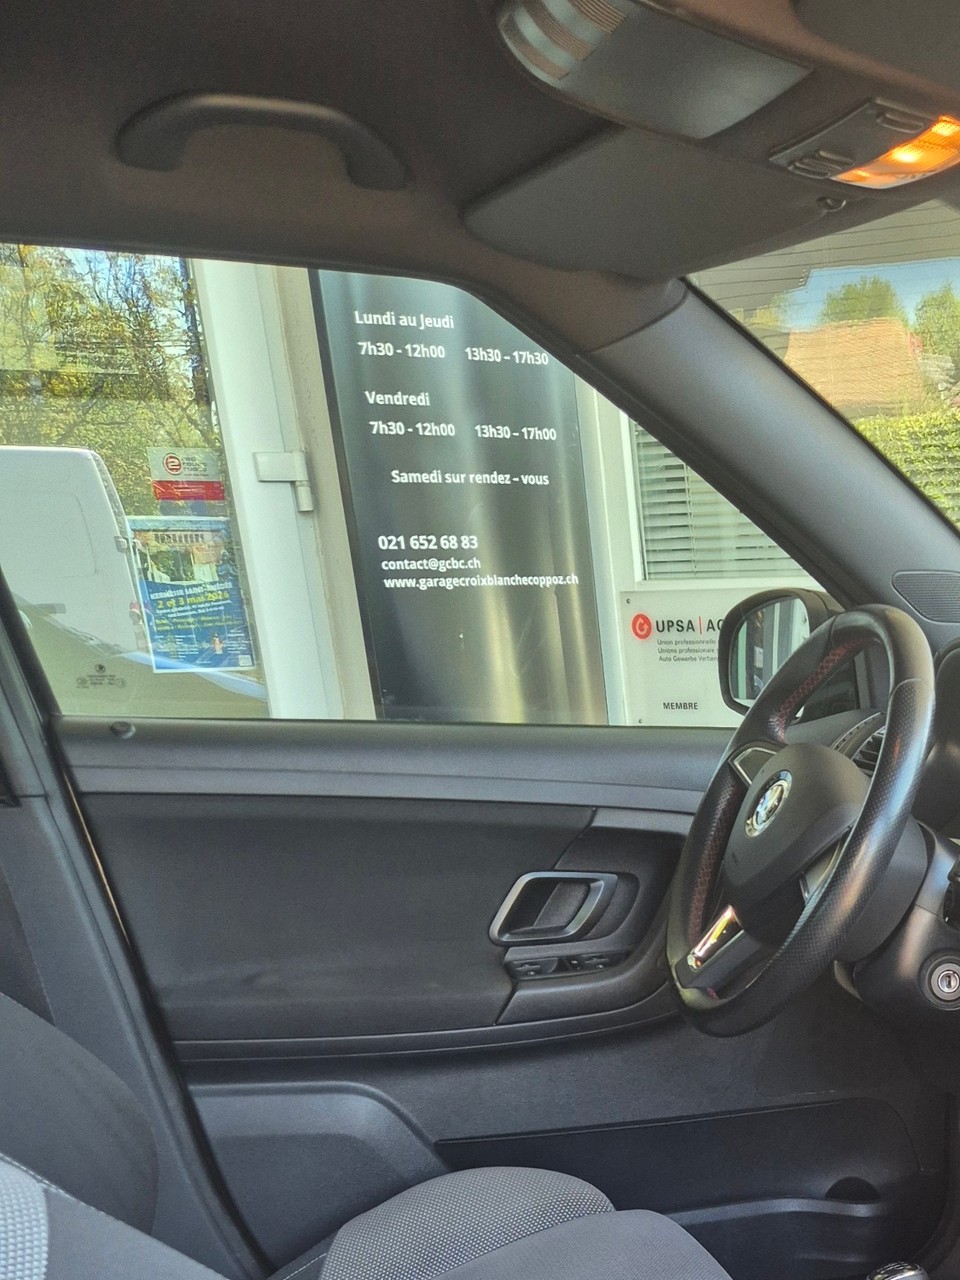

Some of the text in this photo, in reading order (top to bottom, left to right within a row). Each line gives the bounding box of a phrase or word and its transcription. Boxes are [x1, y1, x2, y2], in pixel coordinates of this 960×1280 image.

[354, 310, 454, 330] Lundi au Jeudi
[357, 341, 394, 357] 7h30
[404, 343, 445, 358] 12h00
[465, 346, 501, 363] 13h30
[512, 350, 549, 365] 17h30
[364, 390, 431, 406] Vendredi
[368, 420, 405, 435] 7h30
[415, 422, 456, 437] 12h00
[474, 424, 511, 439] 13h30
[521, 427, 557, 441] 17h00
[391, 469, 442, 483] Samedi
[444, 471, 466, 483] sur
[469, 471, 511, 484] rendez
[521, 473, 549, 485] vous
[378, 535, 478, 550] 021 652 68 83
[381, 556, 481, 572] contact@gcbc.ch
[383, 572, 579, 591] www.garagecroixblanchecoppoz.ch
[655, 619, 695, 633] UPSA
[662, 702, 698, 711] MEMBRE
